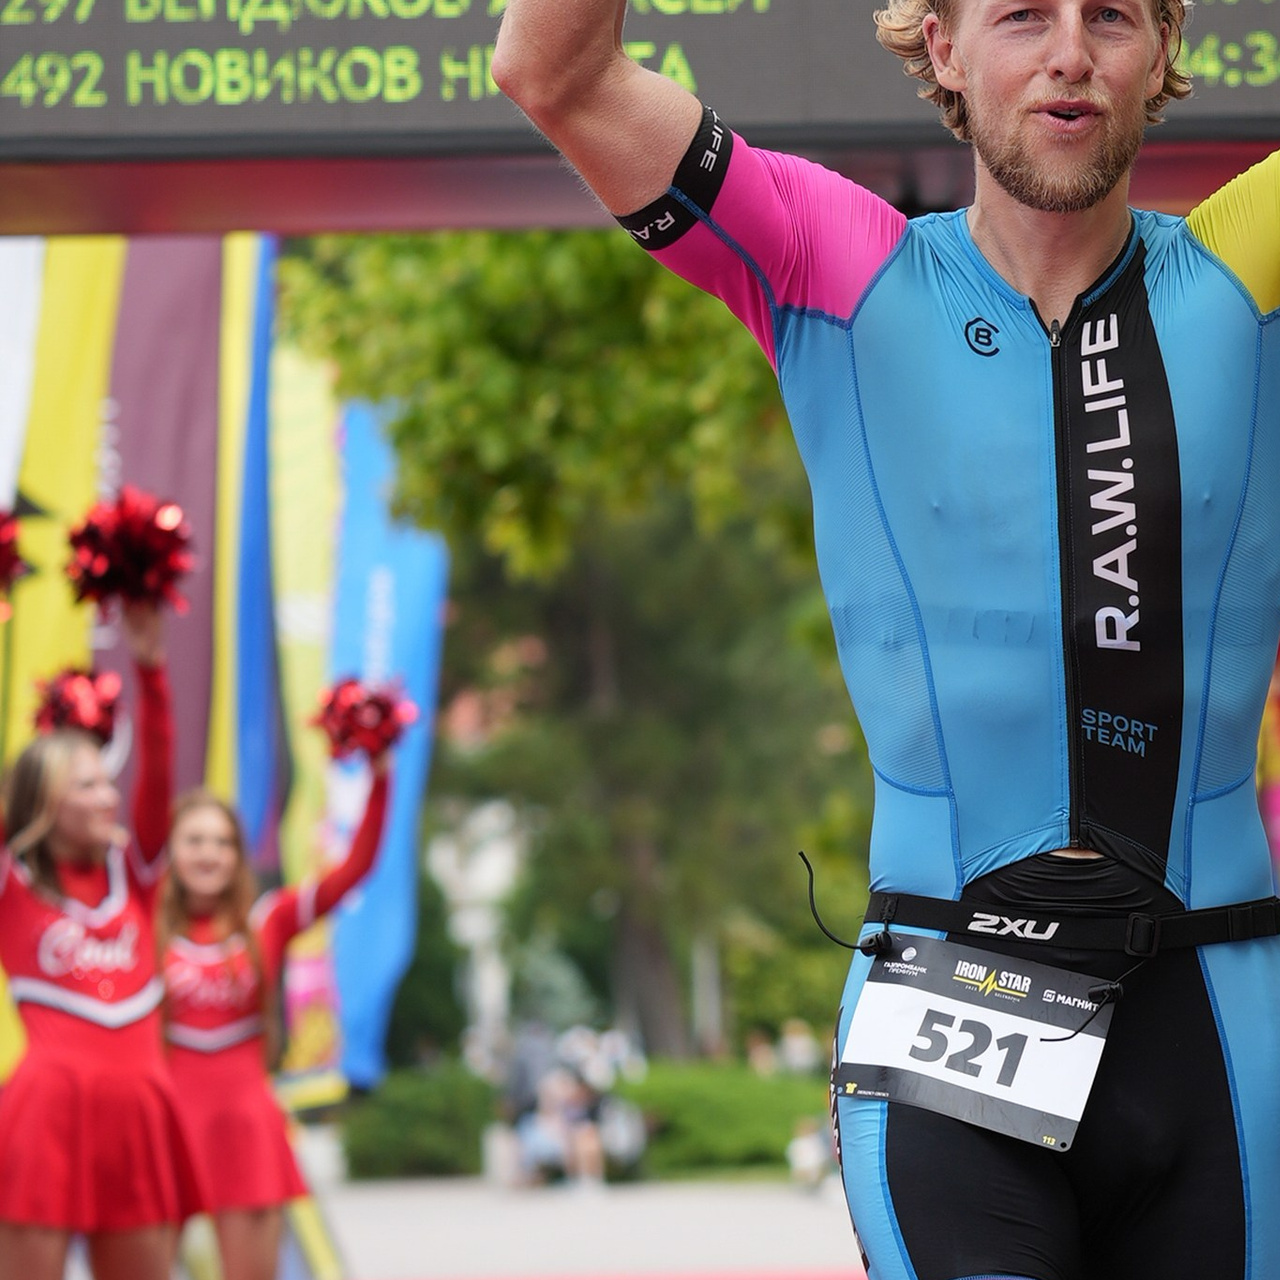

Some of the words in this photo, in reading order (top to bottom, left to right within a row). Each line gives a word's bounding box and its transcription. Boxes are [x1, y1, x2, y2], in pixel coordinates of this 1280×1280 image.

[0, 51, 107, 108] 492
[126, 44, 422, 107] НОВИКОВ
[1080, 313, 1141, 652] R.A.W.LIFE
[1081, 708, 1159, 742] SPORT
[1081, 724, 1146, 758] TEAM
[967, 912, 1060, 941] 2XU
[955, 960, 988, 982] IRON
[998, 971, 1032, 993] STAR
[1055, 993, 1100, 1012] МАГНИТ
[908, 1008, 1029, 1088] 521
